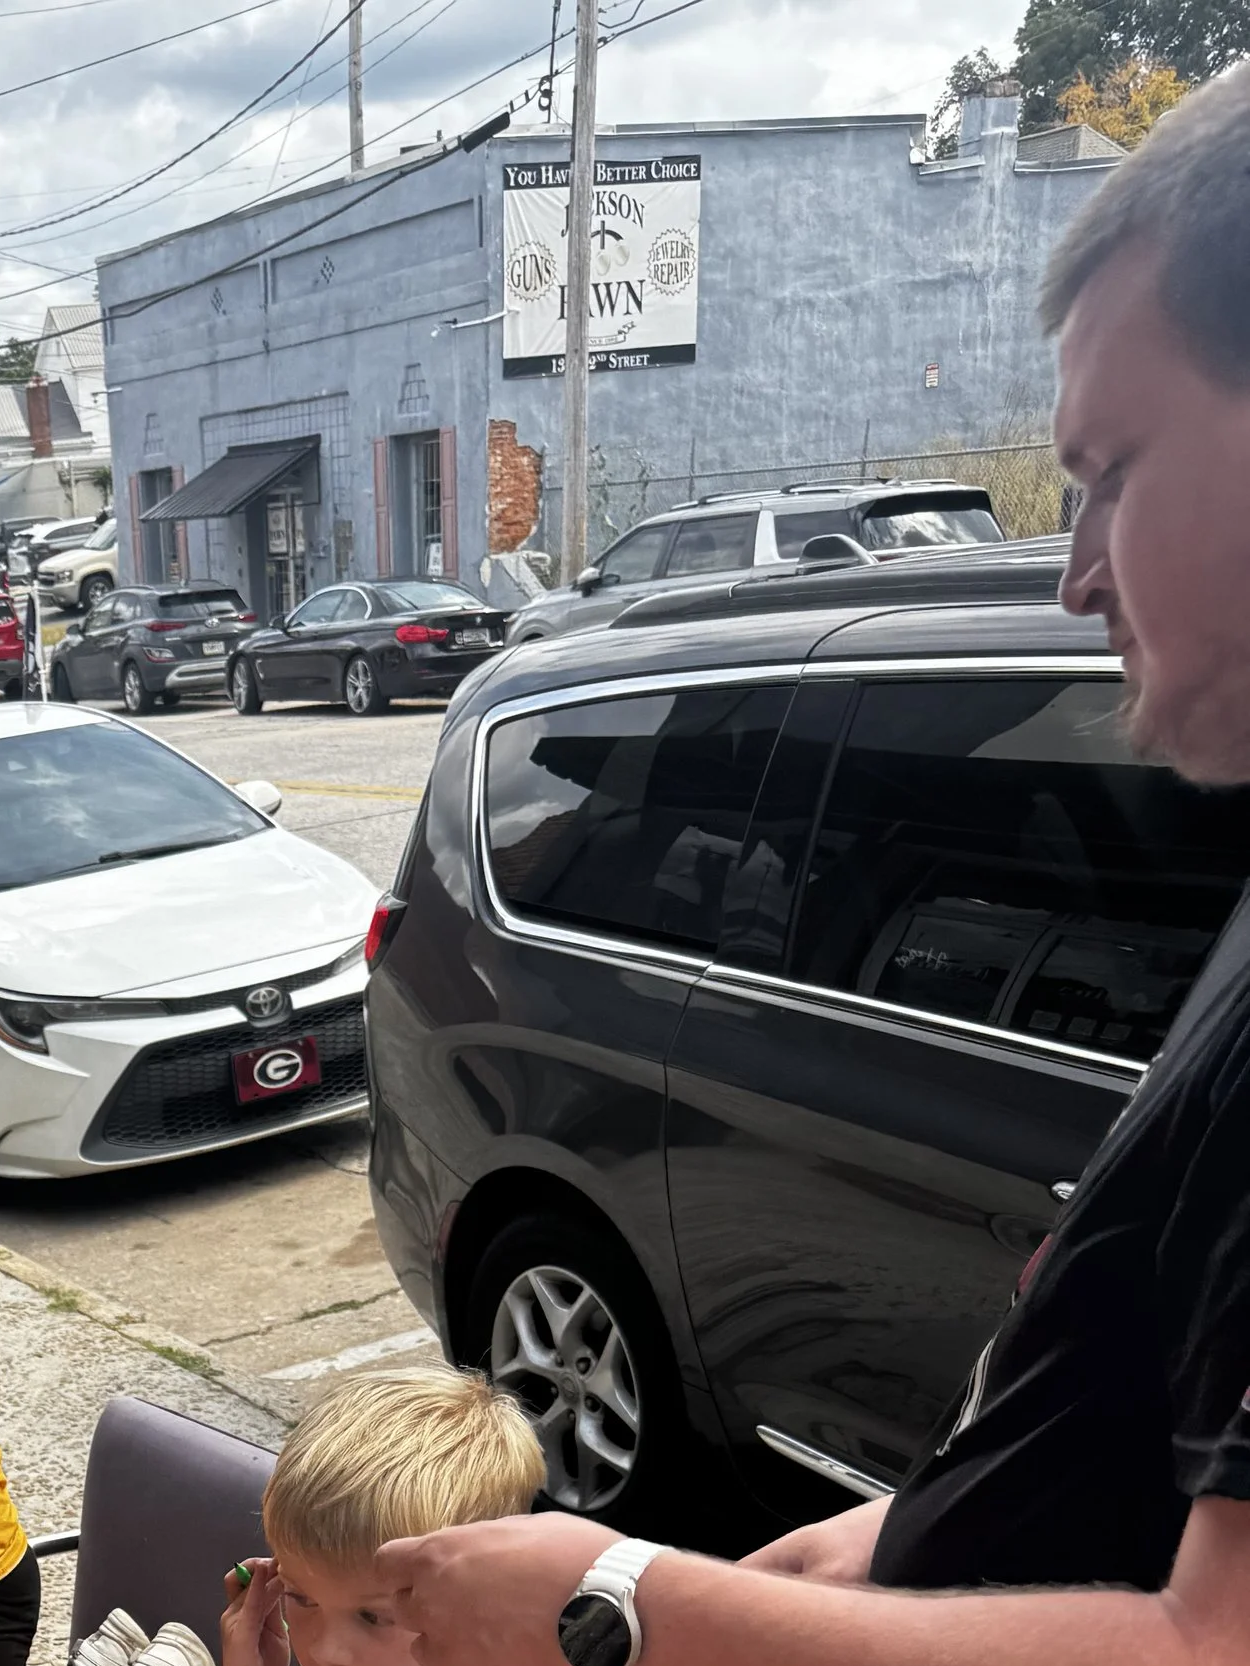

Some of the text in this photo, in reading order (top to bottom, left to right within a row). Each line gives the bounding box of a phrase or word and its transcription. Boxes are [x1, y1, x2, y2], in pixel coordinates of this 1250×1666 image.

[541, 165, 571, 185] HAV
[597, 163, 646, 182] BETTER
[651, 160, 698, 179] CHOICE
[561, 190, 645, 238] JKSON
[651, 240, 690, 262] JEWELRY
[511, 253, 551, 292] GUNS
[653, 261, 690, 285] REPAIR
